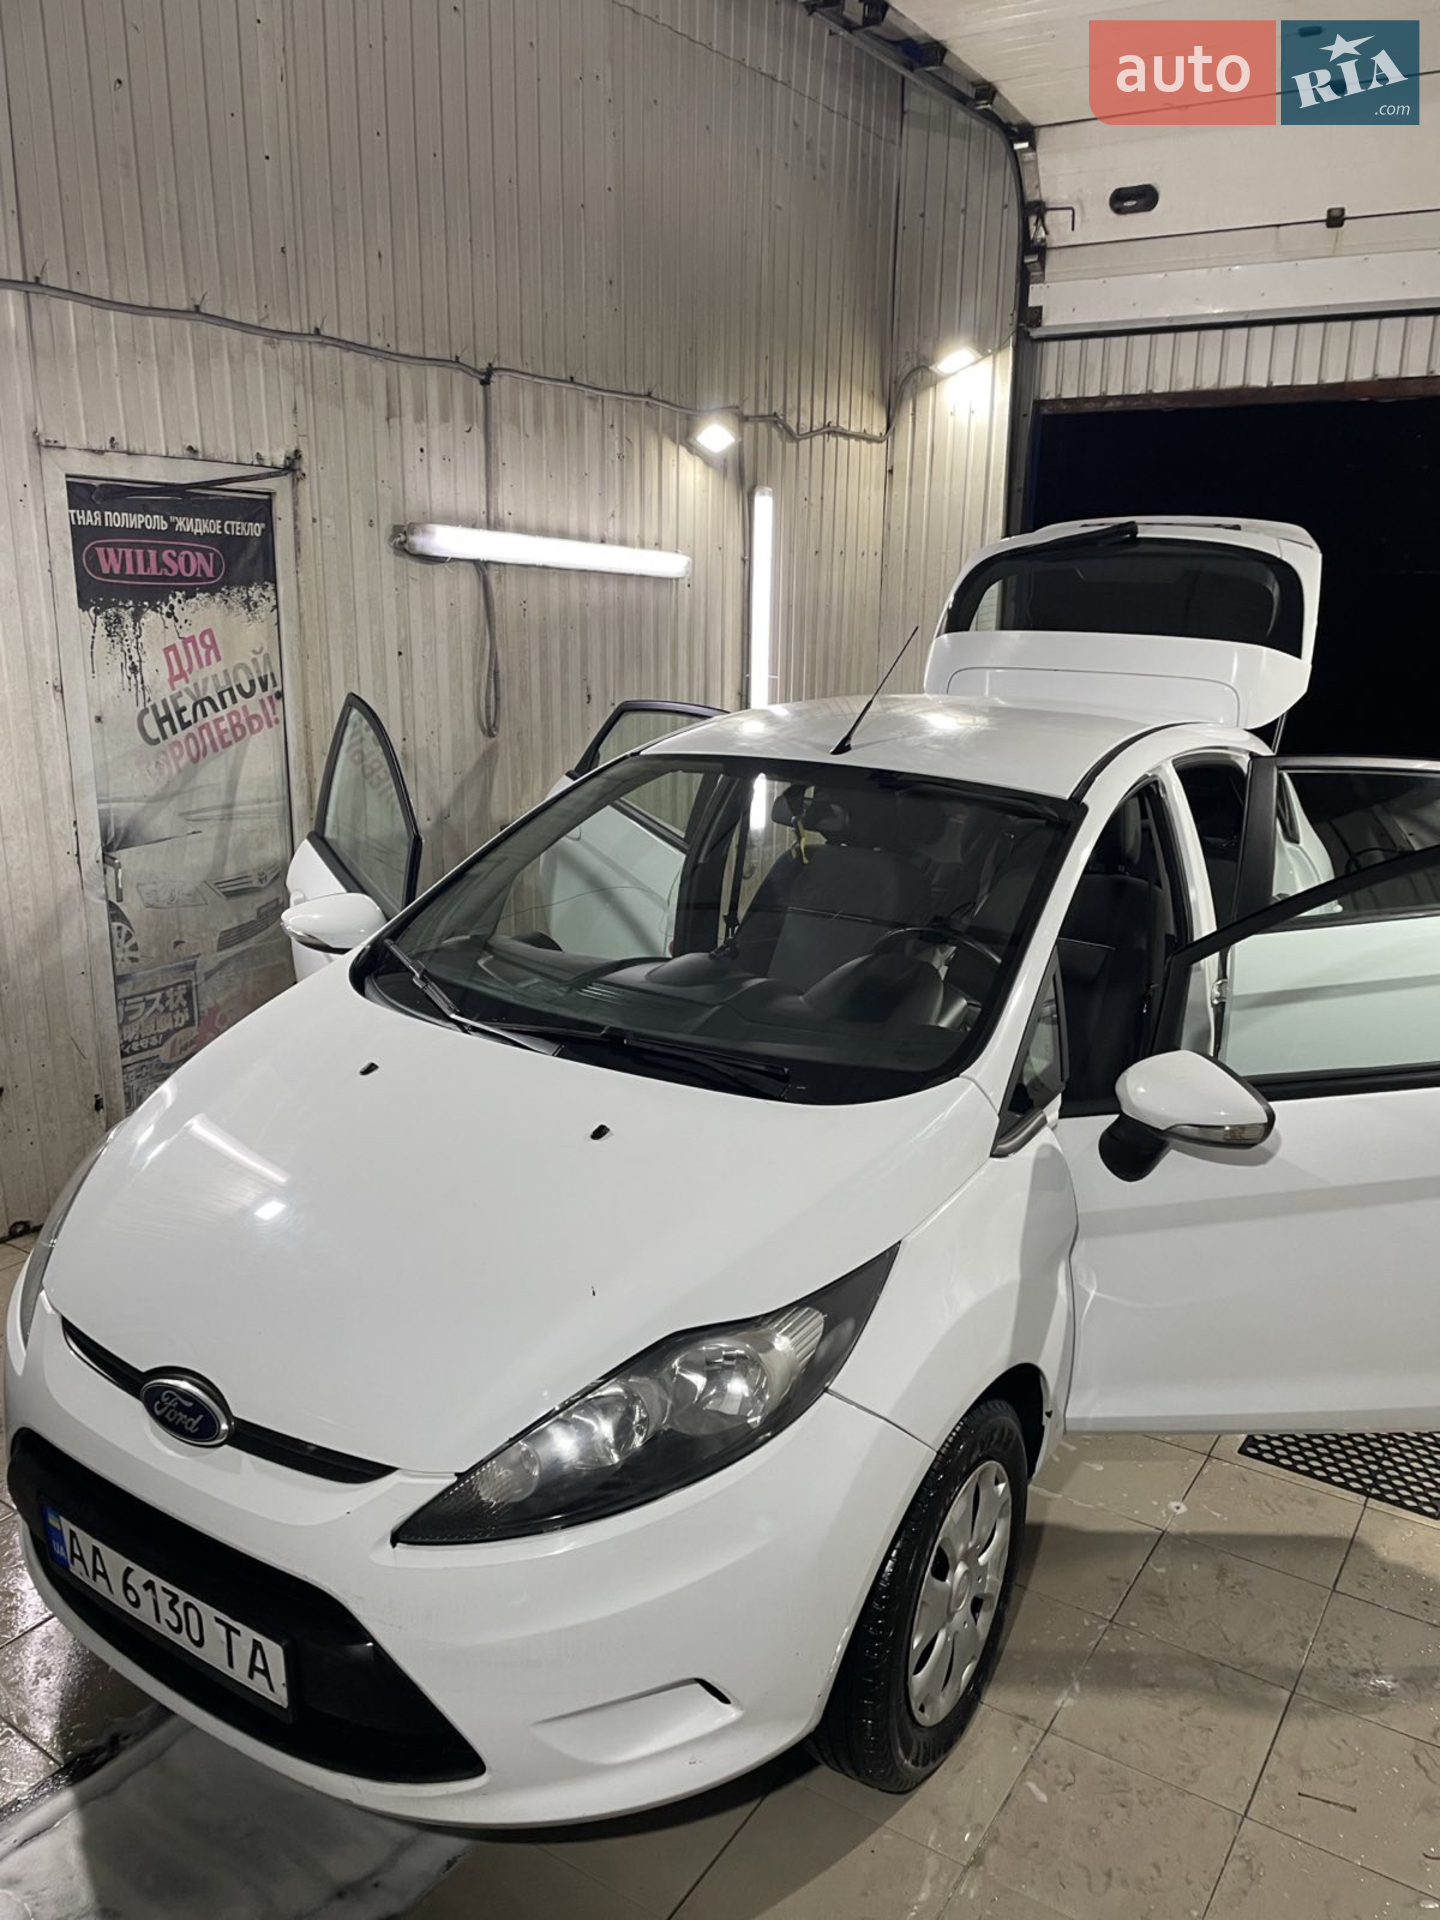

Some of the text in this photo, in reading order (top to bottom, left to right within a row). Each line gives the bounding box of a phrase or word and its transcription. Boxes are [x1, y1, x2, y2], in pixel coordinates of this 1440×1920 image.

[68, 509, 266, 537] ТНАЯ ПОЛИРОЛЬ "ЖИДКОЕ СТЕКЛО"
[94, 546, 216, 578] WILLSON
[163, 627, 221, 691] ДЛЯ
[136, 646, 278, 746] СНЕЖНОЙ
[153, 1389, 204, 1433] Ford
[69, 1527, 275, 1694] AA 6130 TA
